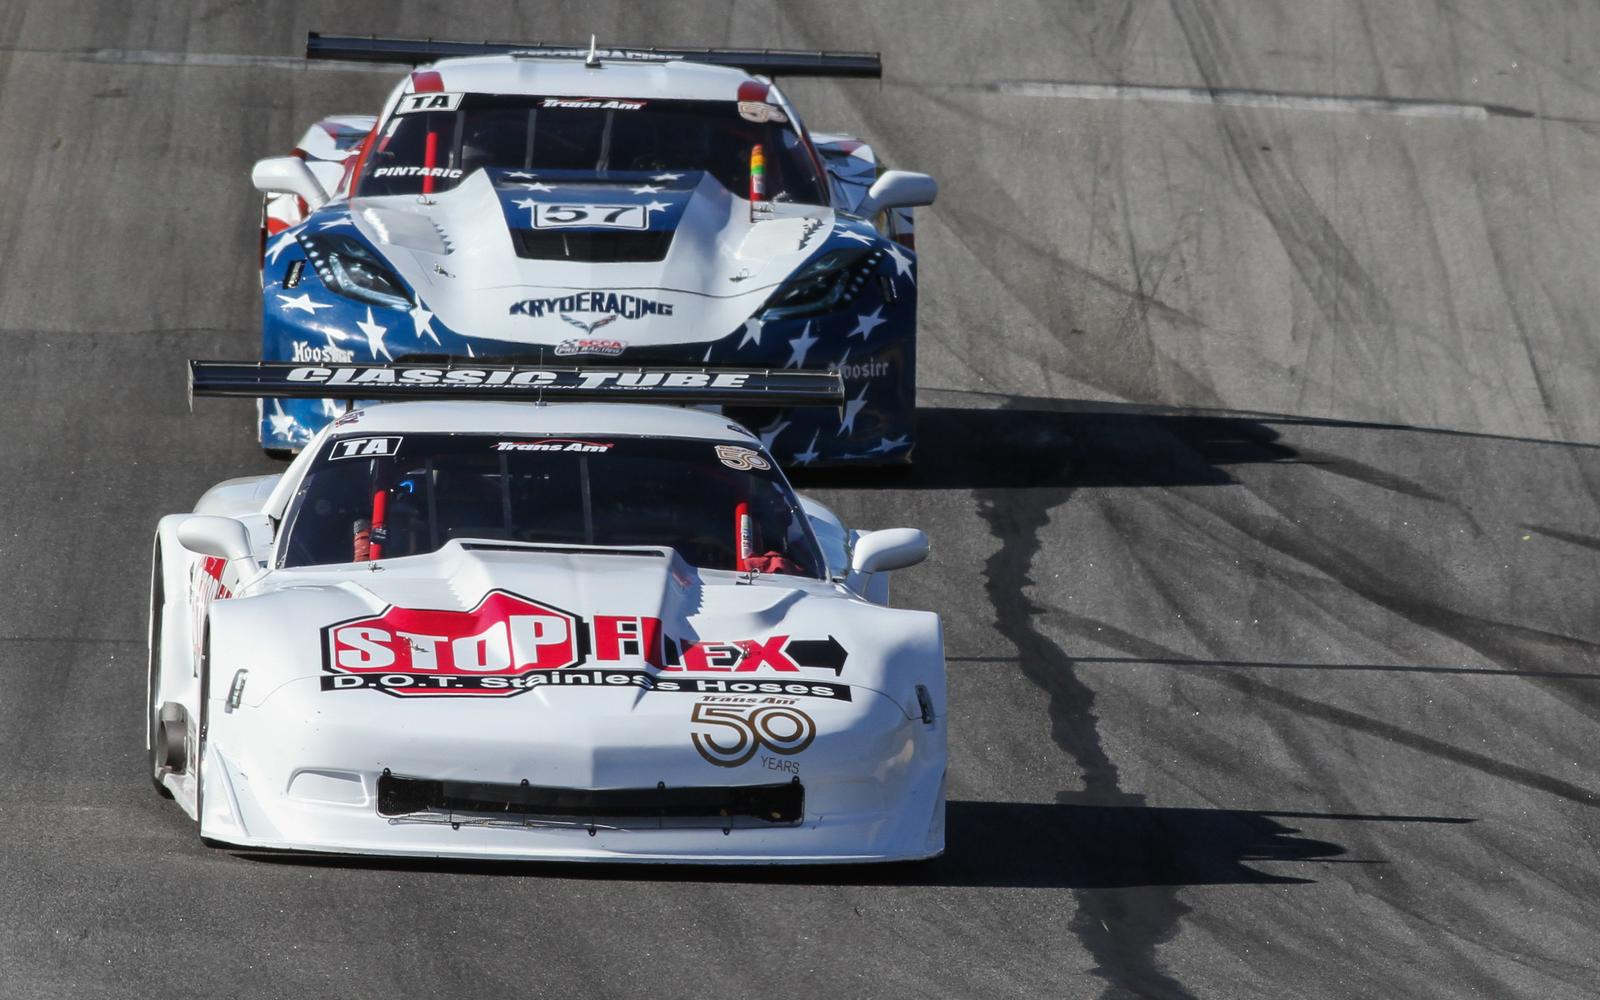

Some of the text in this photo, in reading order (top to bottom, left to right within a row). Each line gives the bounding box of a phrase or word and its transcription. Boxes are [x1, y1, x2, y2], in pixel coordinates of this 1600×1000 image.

[411, 95, 450, 108] TA
[542, 98, 643, 110] Trans Am
[374, 167, 463, 179] PINTARIC
[544, 205, 637, 223] 57
[509, 291, 674, 320] KRYDERACING
[286, 367, 750, 389] CLASSIC TUBE
[343, 439, 388, 456] TA
[497, 441, 608, 453] Trans Am
[337, 615, 568, 672] STOP
[333, 671, 835, 697] D.O.T. Stainless Hoses
[702, 695, 797, 705] Trans Am
[691, 703, 817, 768] 50
[761, 756, 800, 775] YEARS
